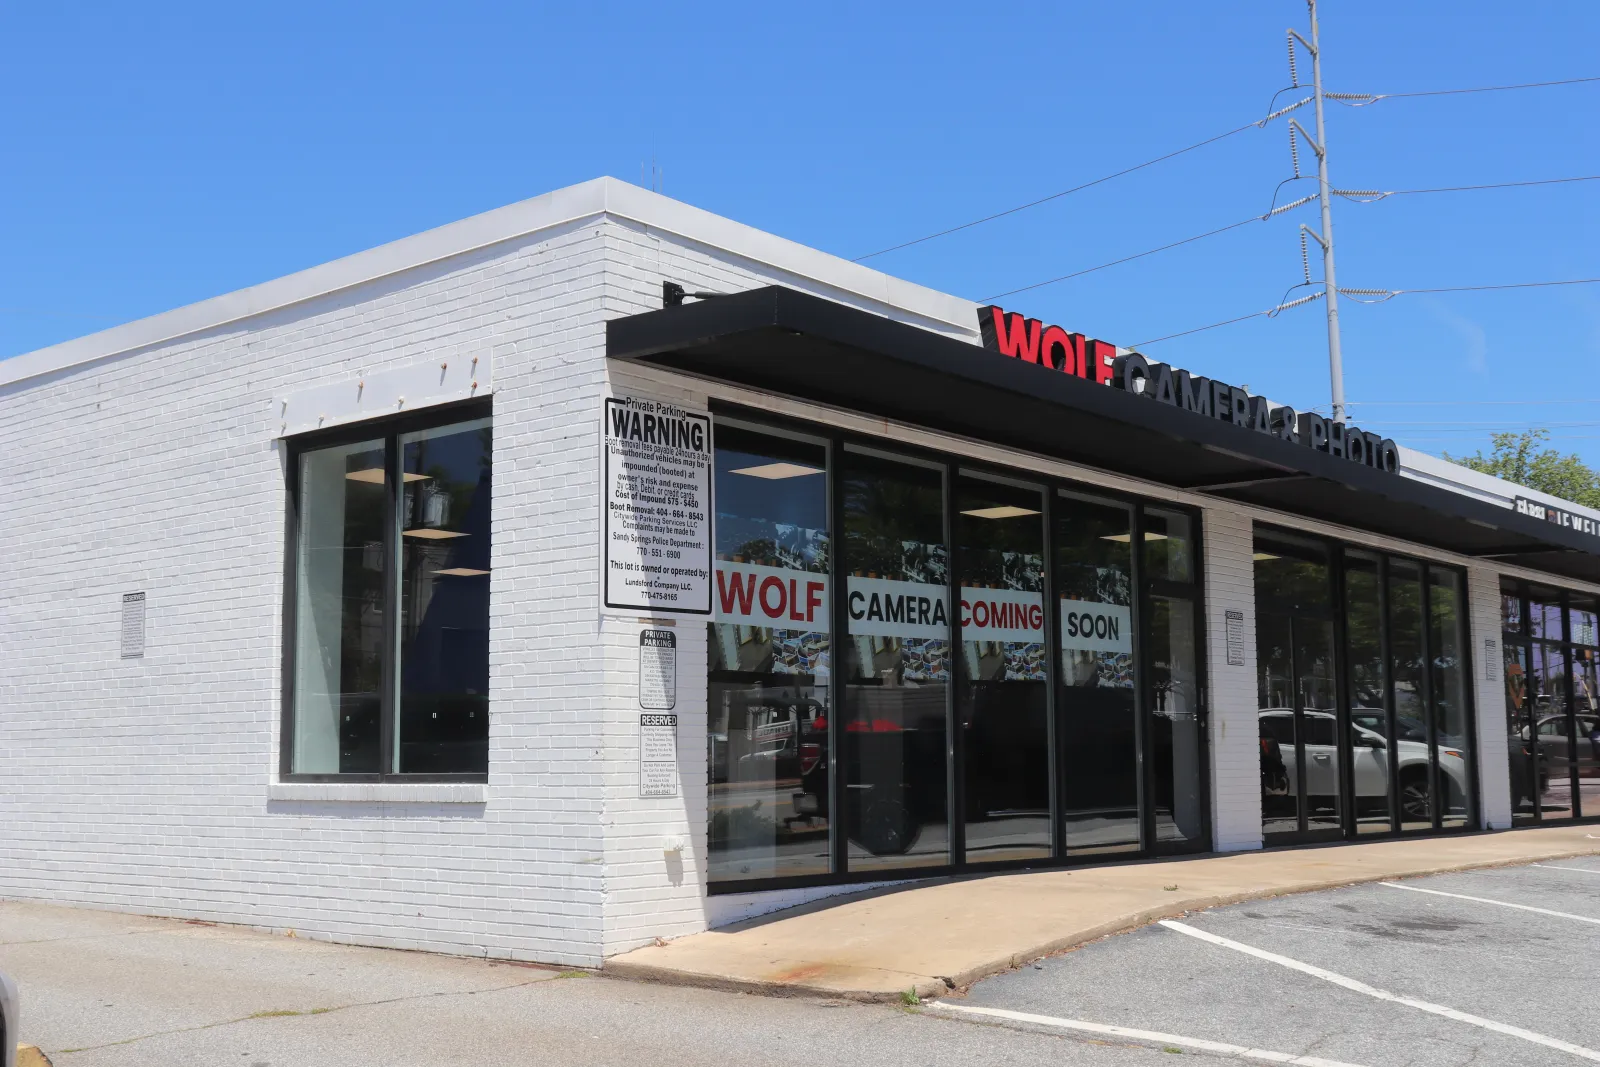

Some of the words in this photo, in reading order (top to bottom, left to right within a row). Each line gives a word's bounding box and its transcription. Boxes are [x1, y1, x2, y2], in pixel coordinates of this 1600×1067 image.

[991, 305, 1116, 386] WOLF
[1121, 353, 1273, 435] CAMERA
[1281, 405, 1299, 443] &
[1309, 413, 1401, 476] PHOTO
[626, 397, 654, 412] Private
[656, 403, 686, 421] Parking
[612, 408, 703, 452] WARNING
[605, 436, 618, 446] Boot
[619, 439, 640, 450] removal
[642, 441, 652, 451] fees
[654, 445, 674, 455] payable
[701, 453, 710, 463] day
[611, 446, 655, 460] Unauthorized
[656, 454, 681, 464] vehicles
[683, 460, 695, 468] may
[697, 460, 704, 468] be
[622, 460, 658, 473] impounded
[659, 466, 686, 478] (booted)
[617, 481, 623, 490] by
[680, 491, 694, 500] cards
[646, 477, 658, 486] risk
[673, 482, 698, 491] expense
[616, 490, 629, 498] Cost
[640, 493, 666, 504] Impound
[668, 497, 679, 506] $75
[684, 499, 698, 508] $450
[610, 502, 625, 510] Boot
[627, 504, 655, 515] Removal:
[656, 508, 668, 516] 404
[673, 510, 684, 518] 664
[689, 512, 704, 521] 8543
[614, 511, 637, 521] Citywide
[640, 515, 660, 525] Parking
[662, 518, 685, 527] Services
[623, 520, 653, 531] Complaints
[655, 525, 665, 534] may
[613, 532, 630, 542] Sandy
[631, 534, 651, 545] Springs
[652, 536, 668, 546] Police
[637, 547, 647, 556] 770
[652, 548, 662, 557] 551
[667, 550, 680, 559] 6900
[611, 560, 623, 570] This
[625, 562, 633, 571] lot
[635, 563, 639, 571] is
[641, 565, 662, 573] owned
[671, 568, 698, 577] operated
[699, 569, 708, 580] by:
[625, 578, 652, 588] Lundsford
[654, 581, 679, 591] Company
[641, 591, 678, 601] 770-475-8165
[716, 569, 824, 622] WOLF
[848, 590, 948, 626] CAMERA
[961, 600, 1043, 630] COMING
[1068, 612, 1119, 640] SOON
[644, 639, 672, 648] PARKING
[646, 630, 670, 639] PRIVATE
[642, 716, 676, 726] RESERVED
